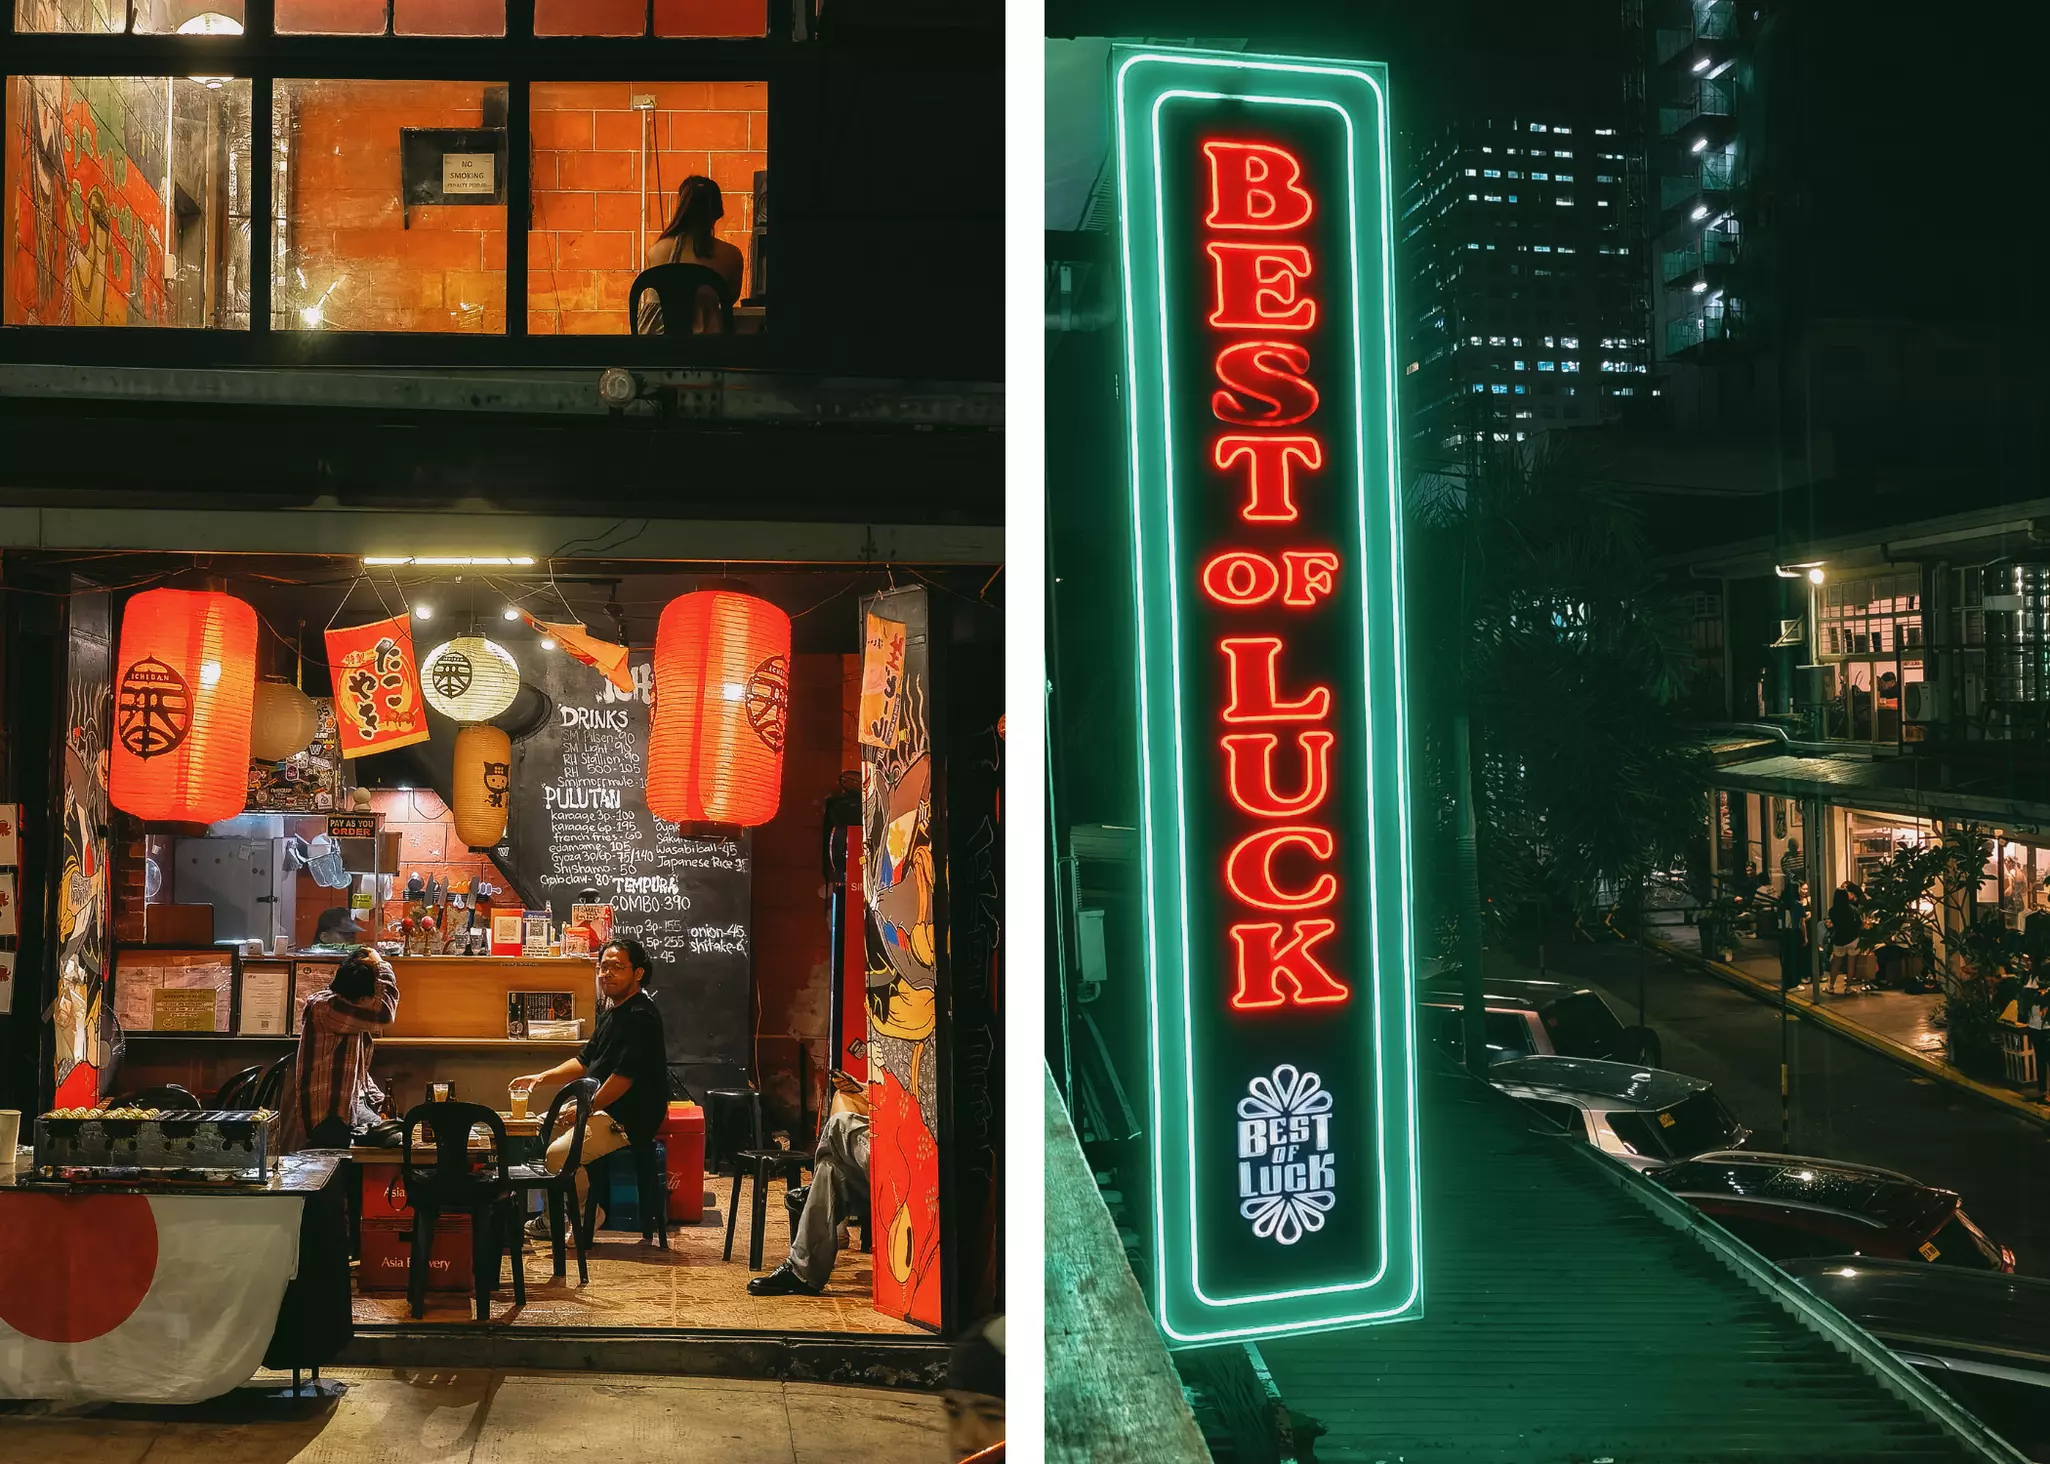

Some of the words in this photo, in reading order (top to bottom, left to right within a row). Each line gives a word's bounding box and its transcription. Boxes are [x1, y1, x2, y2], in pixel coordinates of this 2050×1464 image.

[450, 172, 485, 180] SMOKING
[1203, 141, 1322, 521] BEST
[1203, 552, 1339, 605] OF
[131, 673, 170, 681] ICHIDAN
[559, 705, 630, 731] DRINKS
[562, 742, 580, 753] SM
[542, 785, 621, 810] PULUTAN
[357, 820, 374, 828] YOU
[551, 821, 596, 834] karaage
[1220, 637, 1349, 1008] LUCK
[331, 828, 371, 836] ORDER
[553, 832, 590, 843] french
[656, 855, 711, 871] Japanese
[612, 875, 680, 895] TEMPURA
[1237, 1113, 1333, 1158] BEST
[1271, 1145, 1300, 1164] OF
[1238, 1153, 1336, 1198] LUCK
[381, 1257, 404, 1268] Asia
